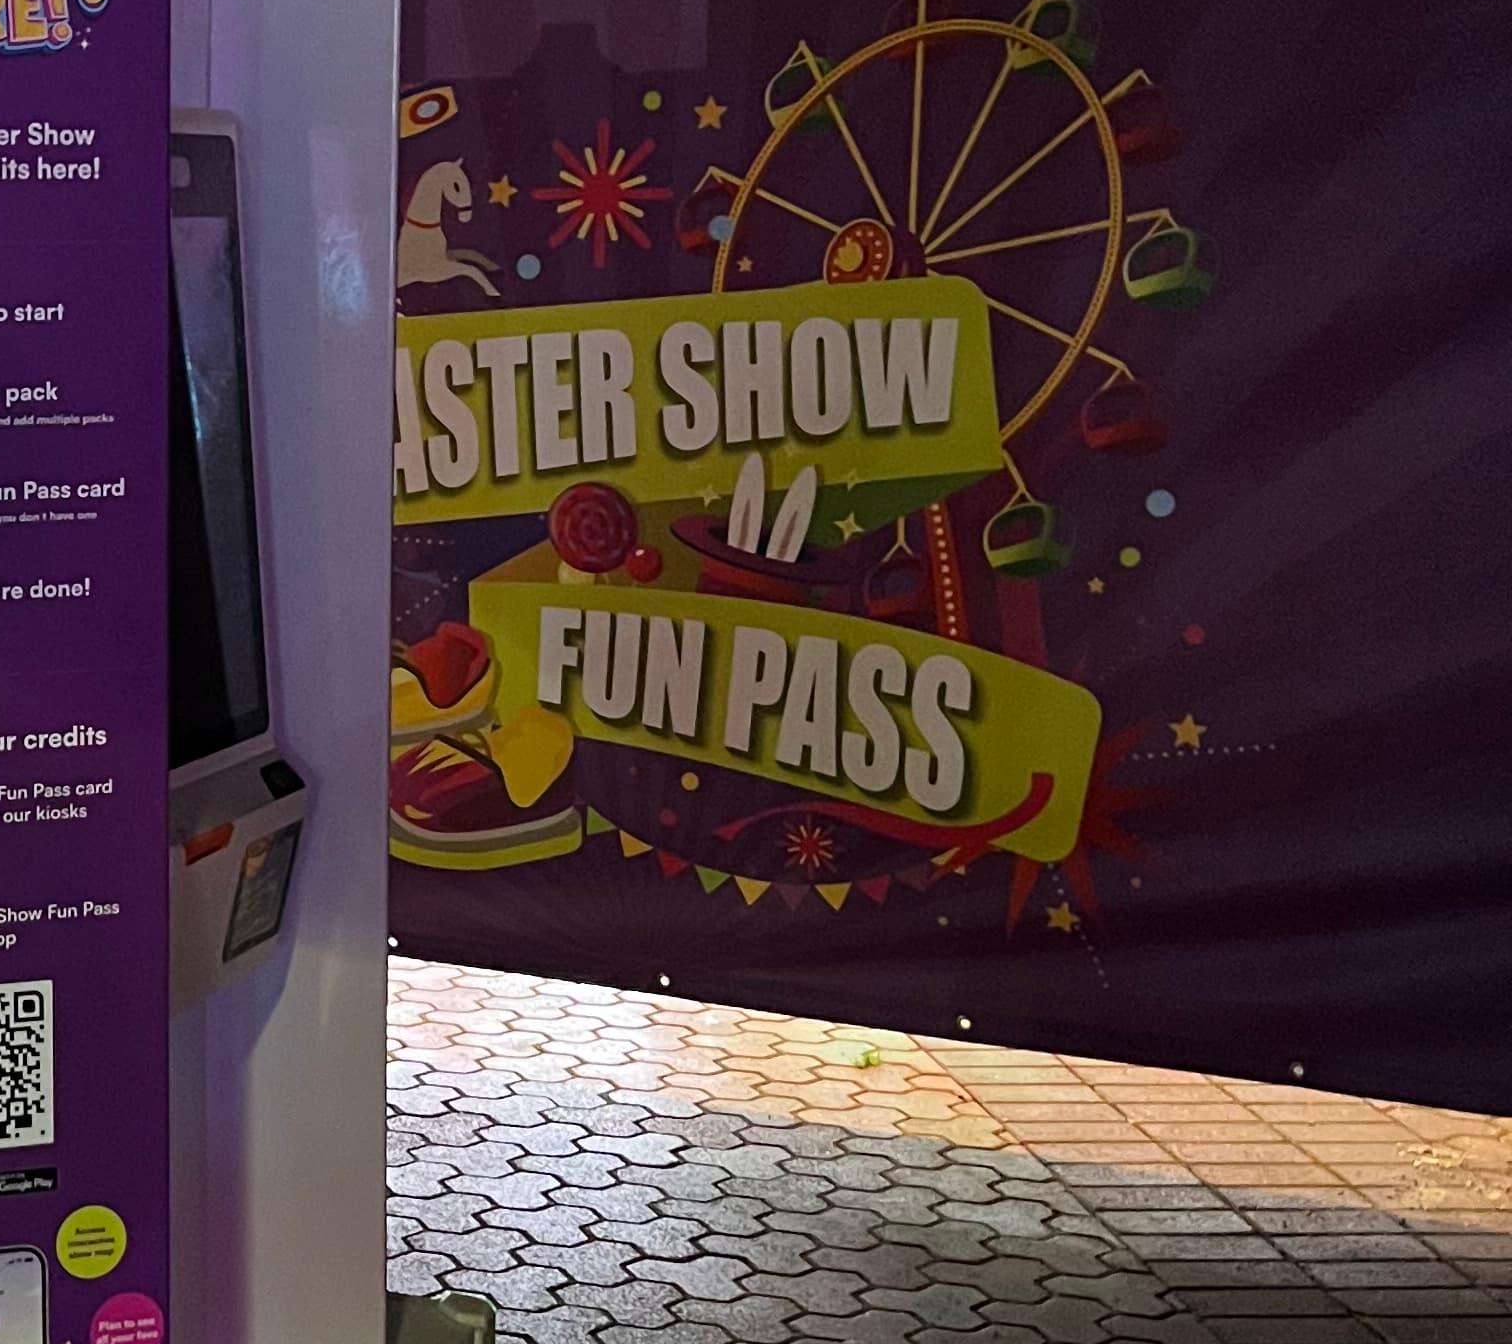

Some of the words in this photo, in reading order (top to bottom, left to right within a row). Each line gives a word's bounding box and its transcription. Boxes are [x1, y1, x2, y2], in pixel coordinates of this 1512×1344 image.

[28, 122, 94, 146] Show
[38, 157, 100, 180] here!
[14, 305, 64, 321] start
[6, 382, 58, 407] pack
[658, 317, 960, 452] SHOW
[13, 415, 34, 425] add
[36, 414, 80, 425] multiple
[82, 414, 114, 424] packs
[23, 481, 70, 500] Pass
[77, 478, 125, 497] card
[19, 512, 47, 522] dont
[50, 510, 74, 521] have
[30, 578, 90, 599] done!
[537, 605, 706, 738] FUN
[723, 625, 972, 812] PASS
[24, 725, 107, 750] credits
[34, 782, 70, 798] Pass
[76, 778, 112, 795] card
[3, 810, 30, 823] our
[36, 804, 87, 821] kiosks
[47, 903, 77, 920] Fun
[83, 900, 120, 917] Pass
[34, 1177, 53, 1188] Play
[98, 1320, 122, 1332] Plan
[124, 1319, 135, 1328] to
